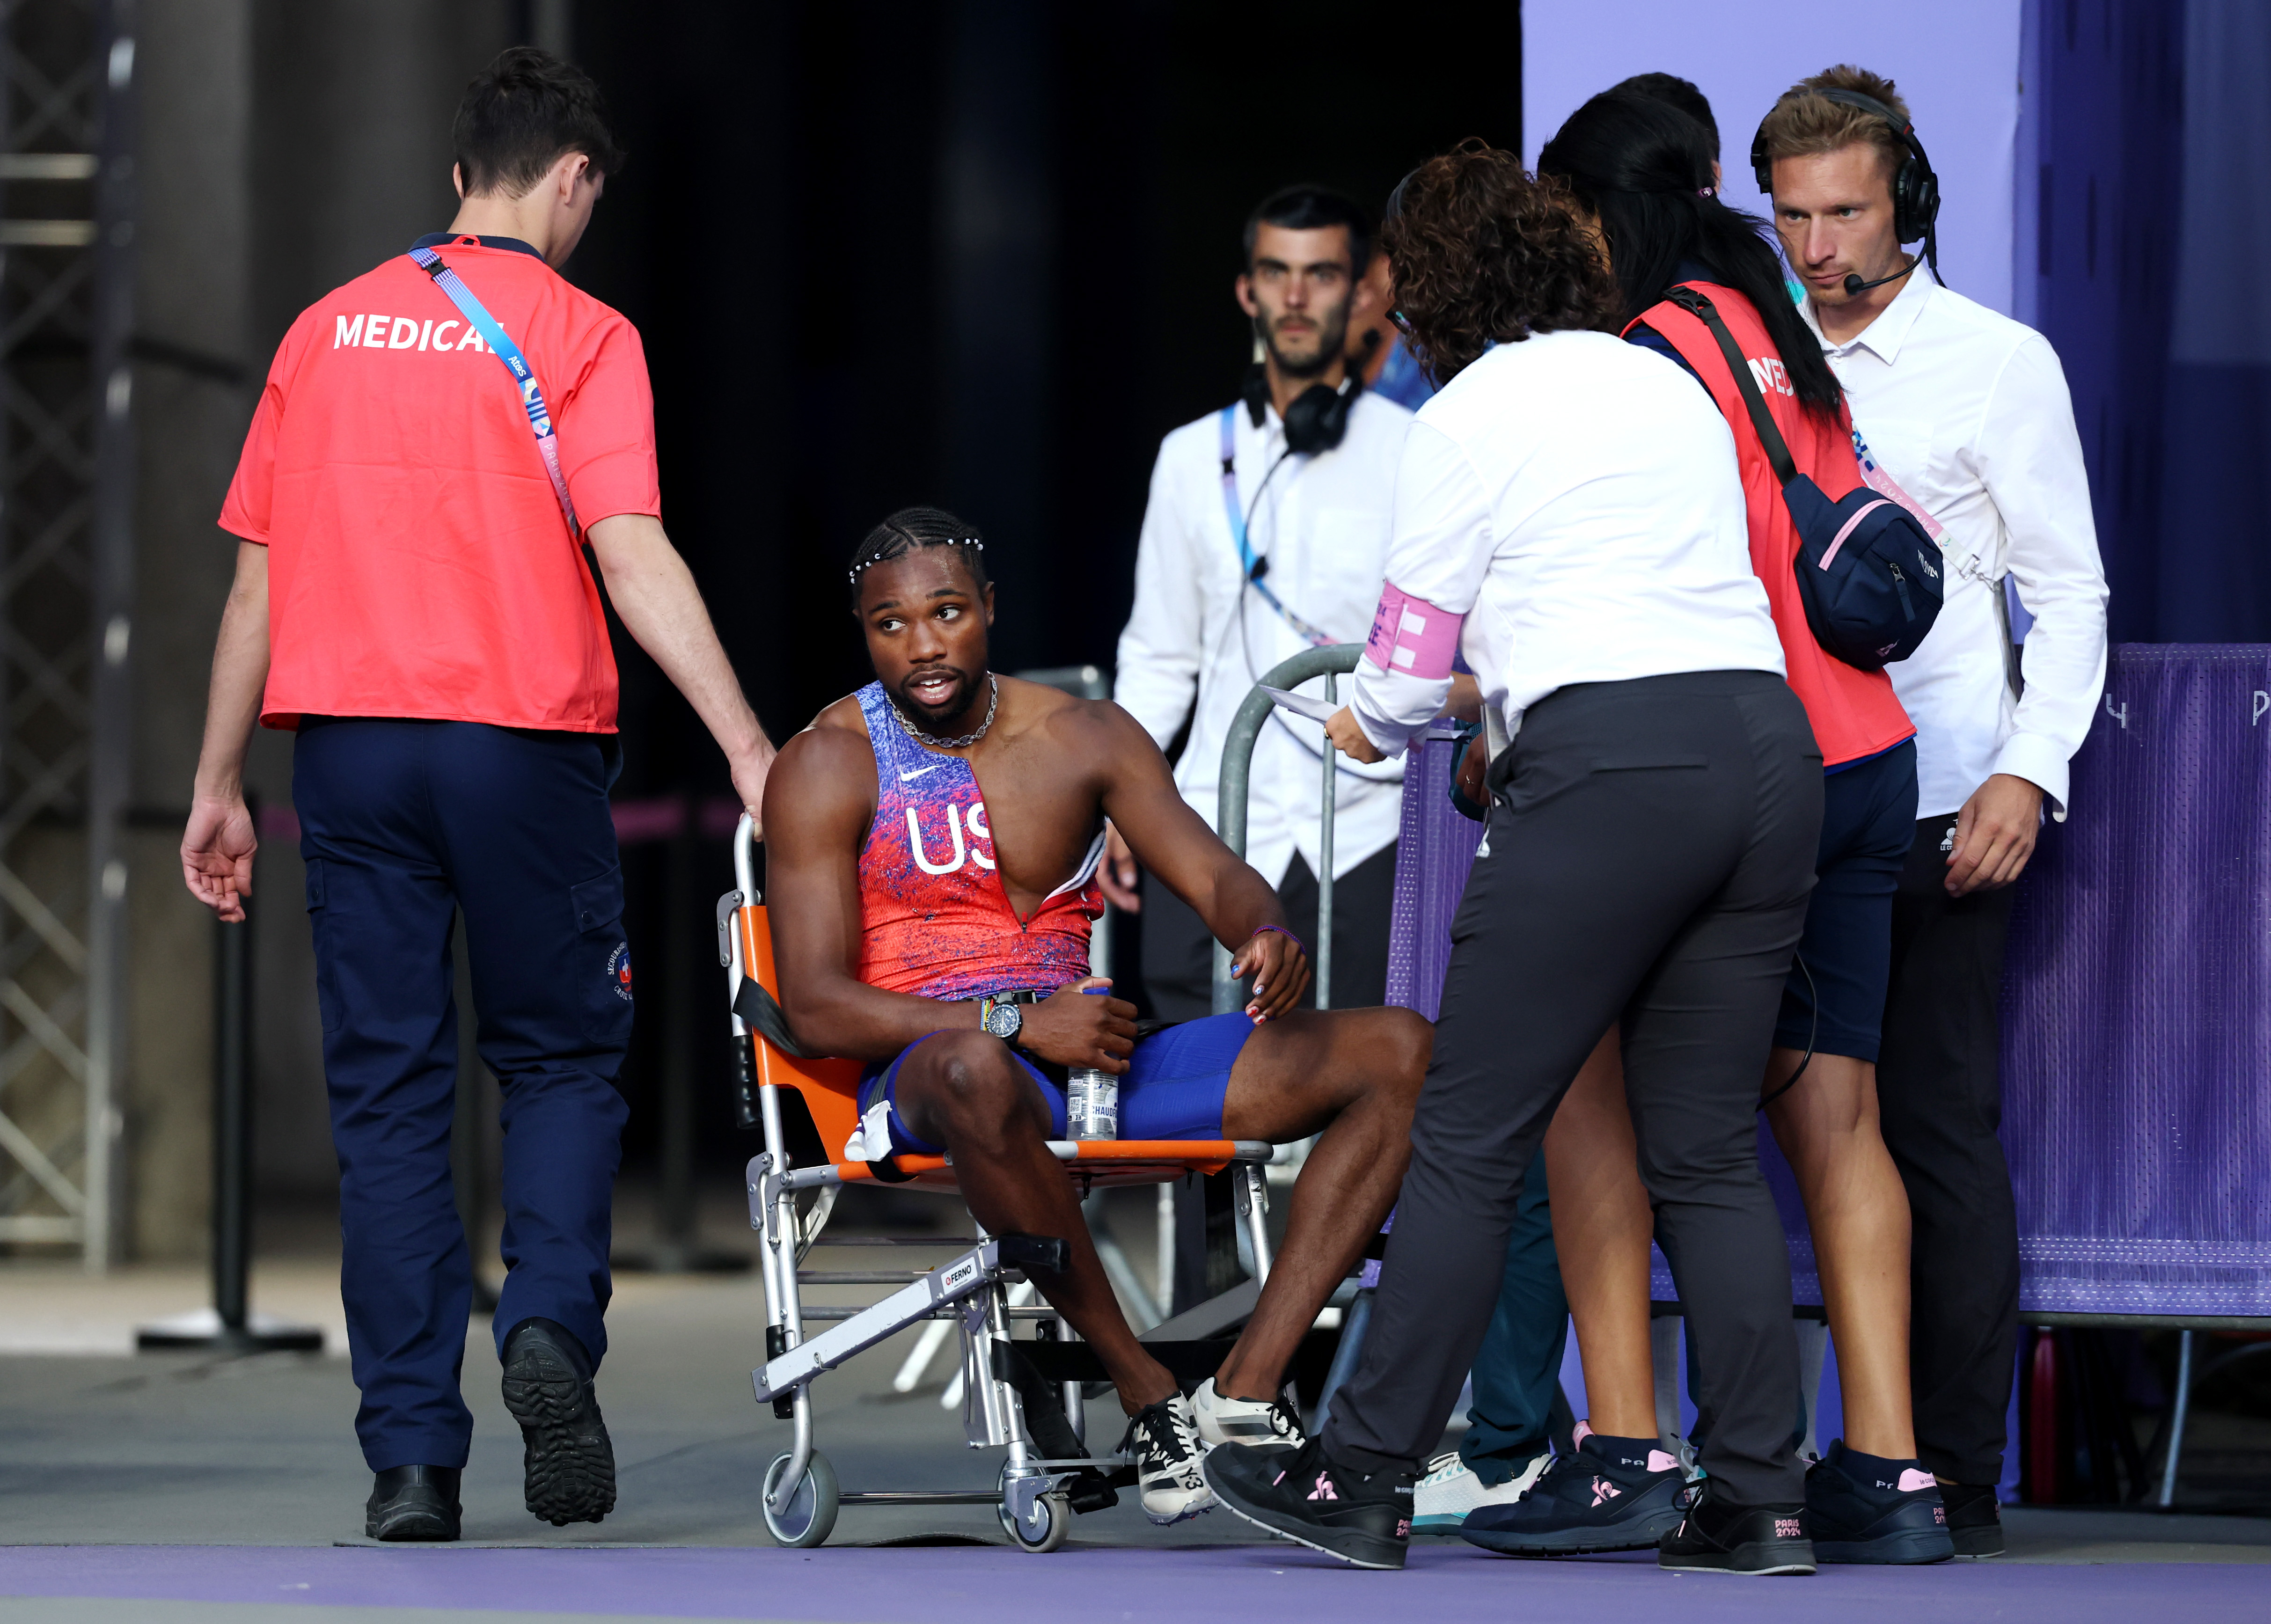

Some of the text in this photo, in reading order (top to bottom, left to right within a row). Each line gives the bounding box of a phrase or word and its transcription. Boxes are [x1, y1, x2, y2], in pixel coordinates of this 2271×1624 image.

[508, 356, 527, 377] Atos
[544, 444, 562, 478] PARIS
[951, 1265, 971, 1283] FERNO
[1775, 1519, 1800, 1529] PARIS
[1776, 1527, 1801, 1537] 2024
